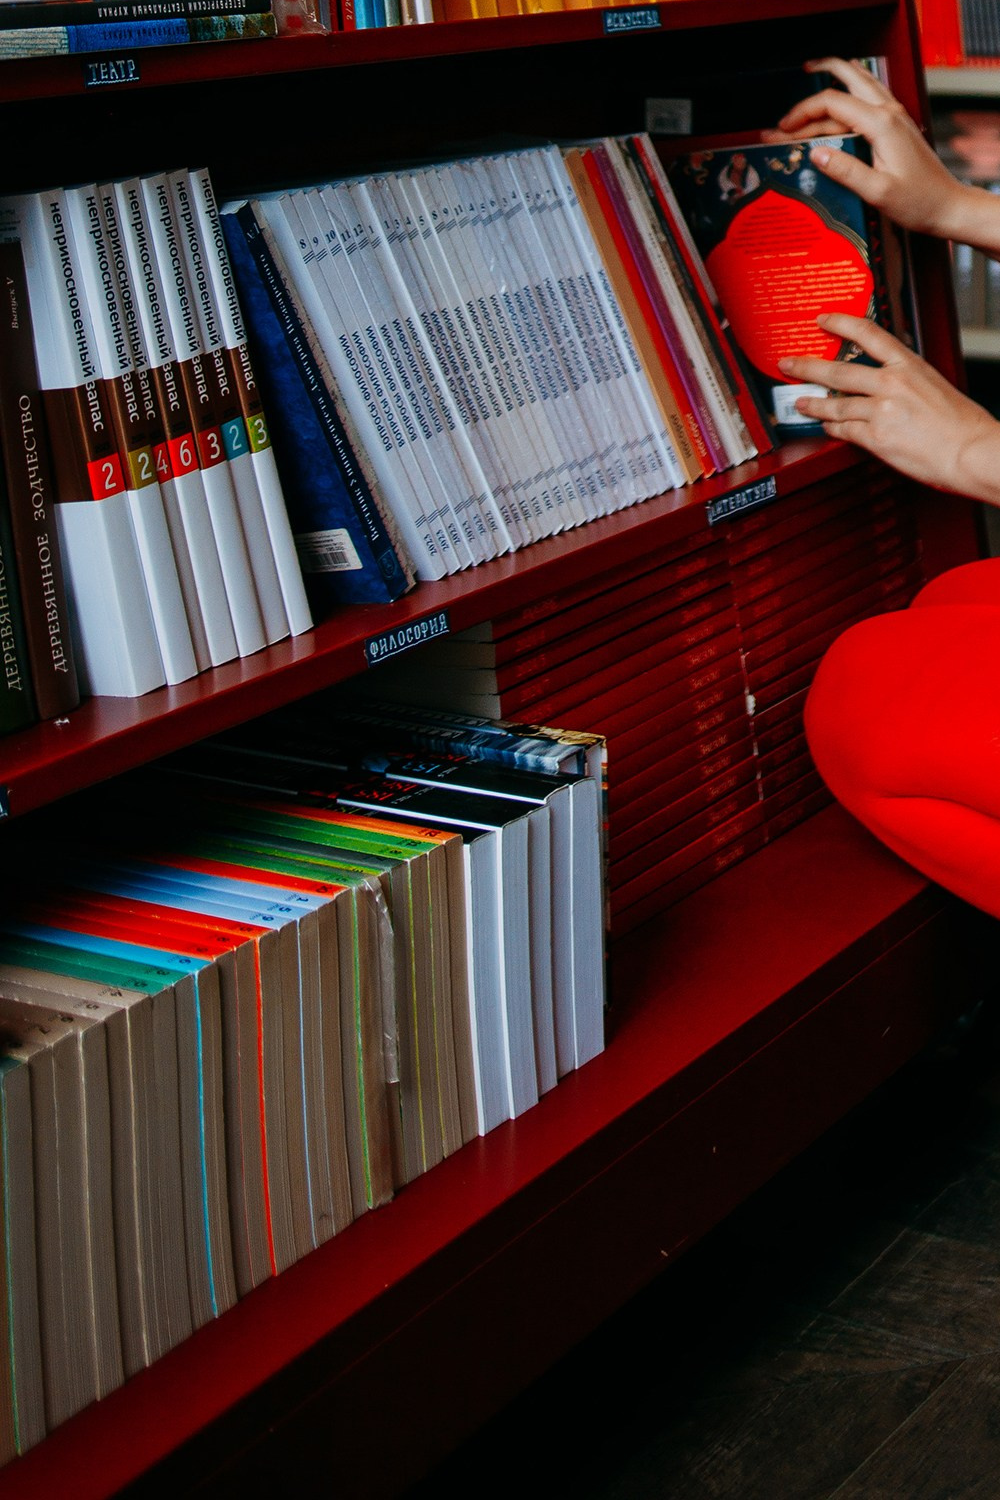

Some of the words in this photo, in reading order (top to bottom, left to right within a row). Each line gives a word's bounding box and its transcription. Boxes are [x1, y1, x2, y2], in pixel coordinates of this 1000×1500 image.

[98, 6, 129, 18] ЖУРНАЛ
[132, 2, 185, 17] ТЕАТРАЛЬНЫЙ
[188, 0, 246, 13] ПЕТЕРБУРГСКИЙ
[88, 59, 136, 81] ТЕАТР
[313, 236, 319, 246] 9
[325, 230, 337, 243] 10
[341, 229, 352, 242] 11
[353, 224, 364, 237] 12
[10, 289, 19, 329] Выпуск
[86, 196, 134, 370] неприкосновенный
[121, 372, 140, 422] запас
[103, 196, 150, 368] неприкосновенный
[138, 370, 156, 420] запас
[127, 189, 173, 360] неприкосновенный
[162, 361, 180, 412] запас
[156, 185, 201, 352] неприкосновенный
[191, 355, 210, 404] запас
[177, 181, 222, 346] неприкосновенный
[212, 348, 230, 397] запас
[201, 178, 247, 341] неприкосновенный
[238, 342, 256, 391] запас
[259, 254, 295, 334] Пожарского
[50, 202, 96, 378] неприкосновенный
[86, 380, 104, 432] запас
[441, 308, 470, 372] ФИЛОСОФИИ
[454, 306, 482, 369] ФИЛОСОФИИ
[351, 331, 383, 398] ФИЛОСОФИИ
[365, 325, 397, 392] ФИЛОСОФИИ
[380, 324, 411, 390] ФИЛОСОФИИ
[392, 319, 423, 384] ФИЛОСОФИИ
[405, 317, 436, 382] ФИЛОСОФИИ
[421, 312, 450, 376] ФИЛОСОФИИ
[430, 310, 459, 375] ФИЛОСОФИИ
[338, 334, 371, 401] ФИЛОСОФИИ
[393, 393, 418, 442] ВОПРОСЫ
[408, 391, 433, 440] ВОПРОСЫ
[419, 385, 444, 433] ВОПРОСЫ
[433, 382, 455, 431] ВОПРОСЫ
[447, 377, 470, 425] ВОПРОСЫ
[456, 376, 480, 423] ВОПРОСЫ
[467, 372, 490, 420] ВОПРОСЫ
[480, 370, 502, 417] ВОПРОСЫ
[206, 432, 221, 459] 3
[229, 424, 243, 451] 2
[254, 419, 268, 444] 3
[317, 397, 356, 486] Университета
[367, 401, 393, 451] ВОПРОСЫ
[381, 398, 405, 447] ВОПРОСЫ
[19, 395, 46, 521] ЗОДЧЕСТВО
[101, 462, 117, 490] 2
[137, 452, 153, 480] 2
[156, 449, 168, 475] 4
[179, 440, 192, 467] 6
[355, 488, 381, 542] Вестник
[37, 533, 68, 673] ДЕРЕВЯННОЕ
[369, 613, 447, 658] ФИЛОСОФИЯ
